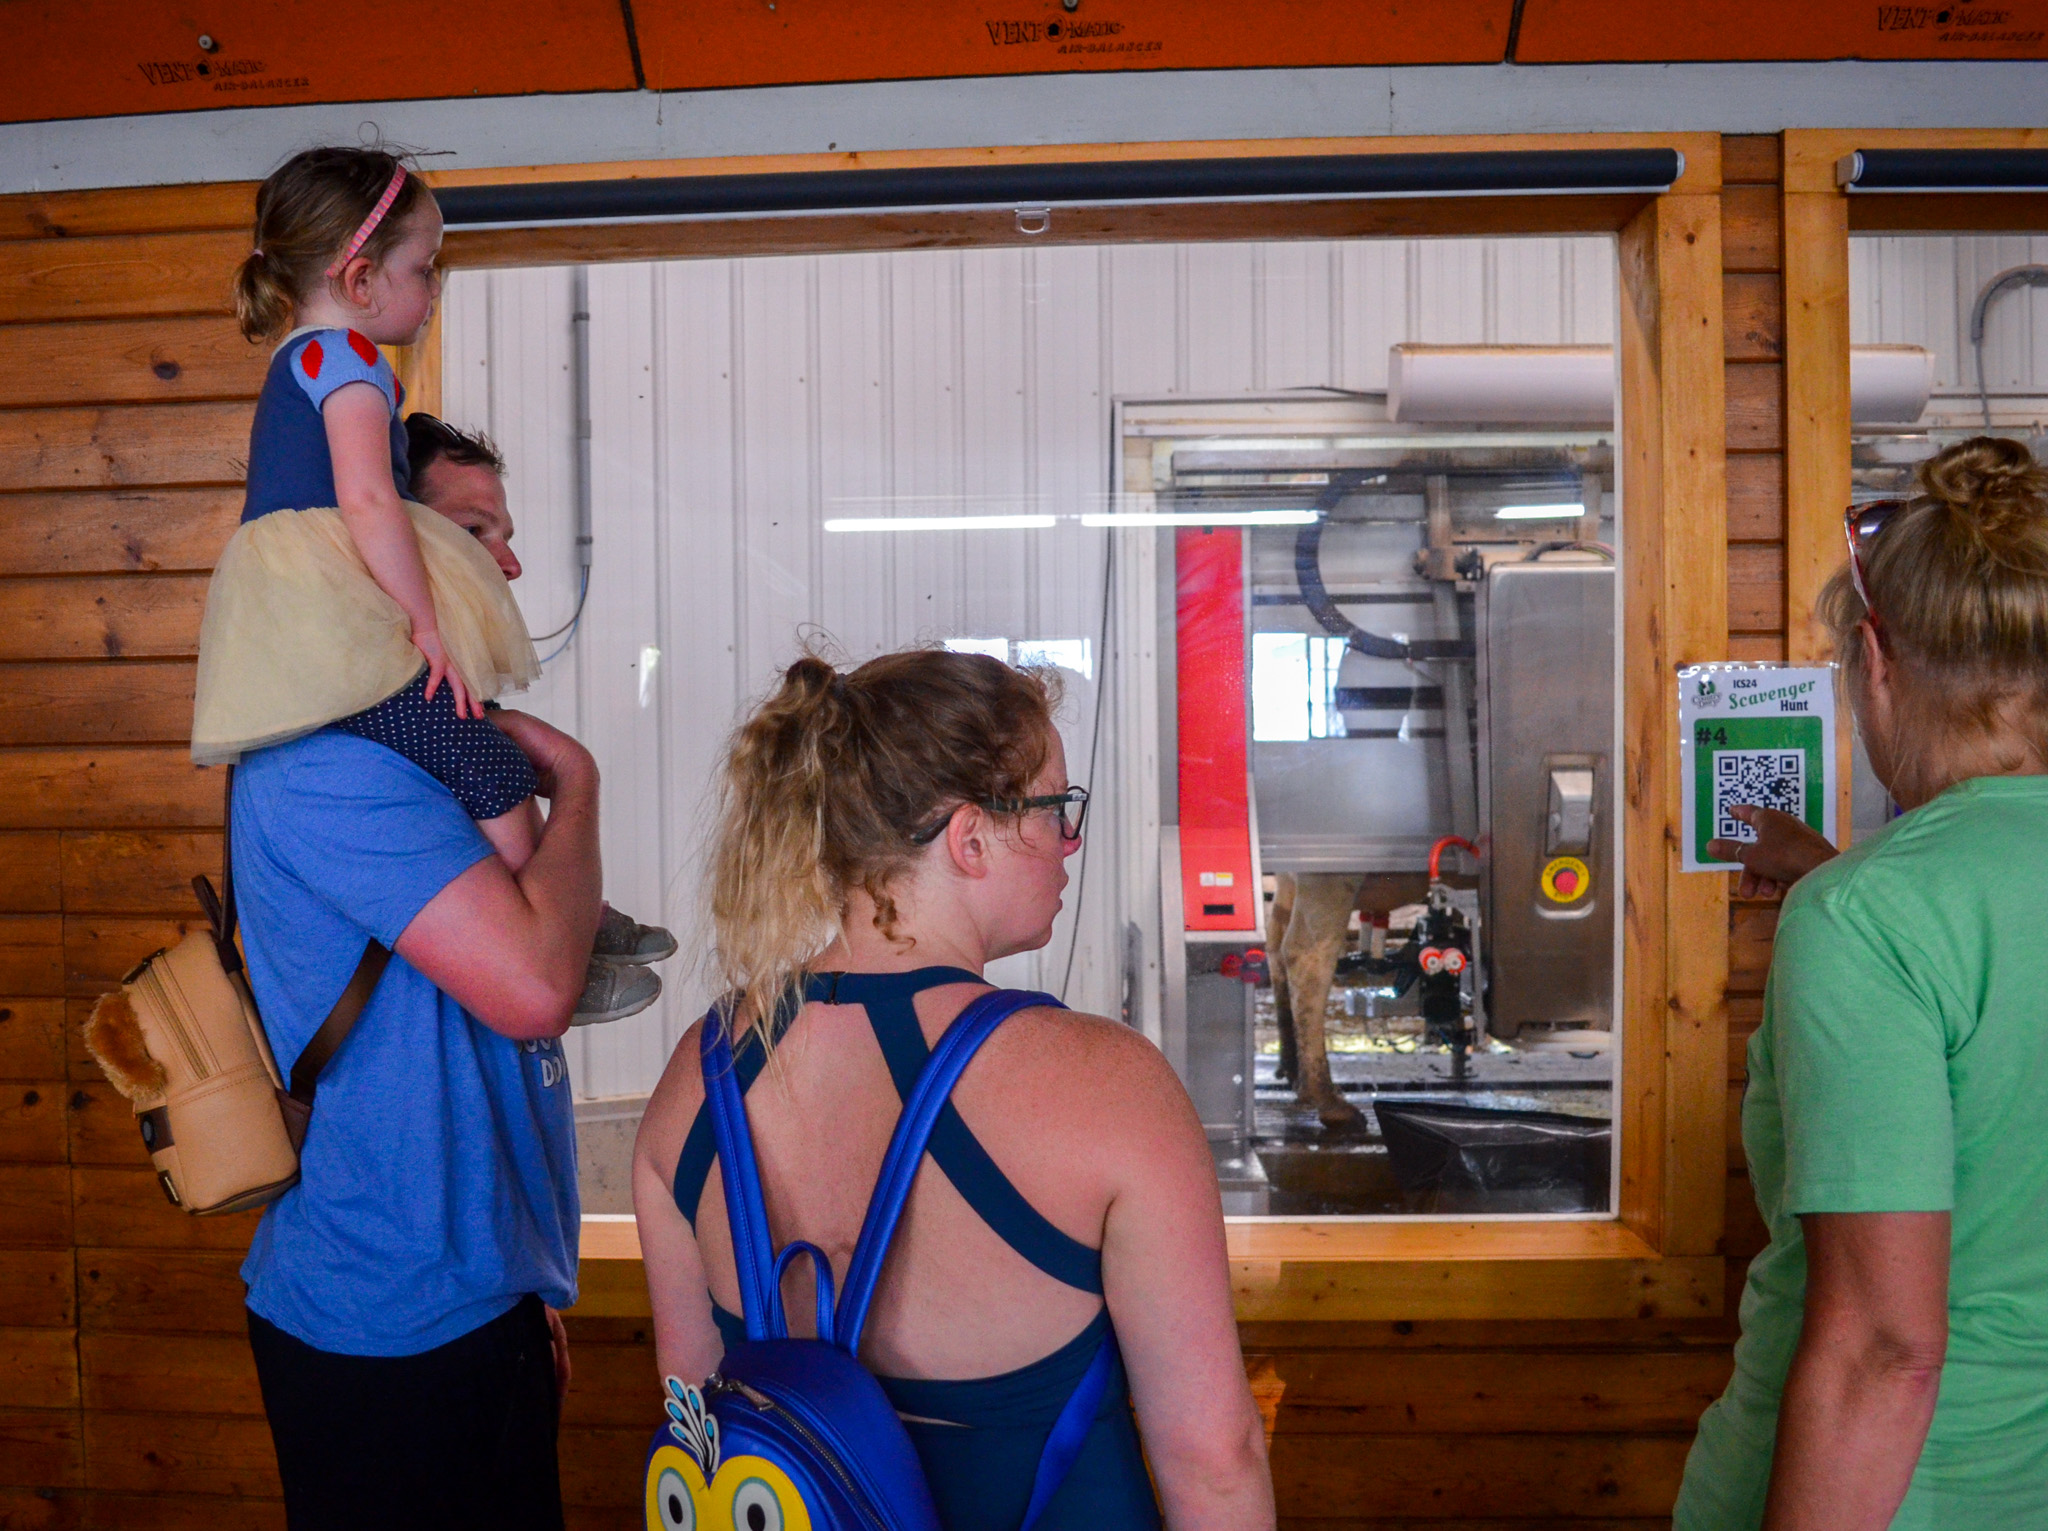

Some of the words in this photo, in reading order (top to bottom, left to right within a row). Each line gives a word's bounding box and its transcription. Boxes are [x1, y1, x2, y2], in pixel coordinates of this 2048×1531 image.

[1733, 679, 1758, 689] ICS24
[1728, 680, 1816, 710] Scavenger
[1780, 699, 1809, 712] Hunt
[1696, 727, 1728, 746] #4
